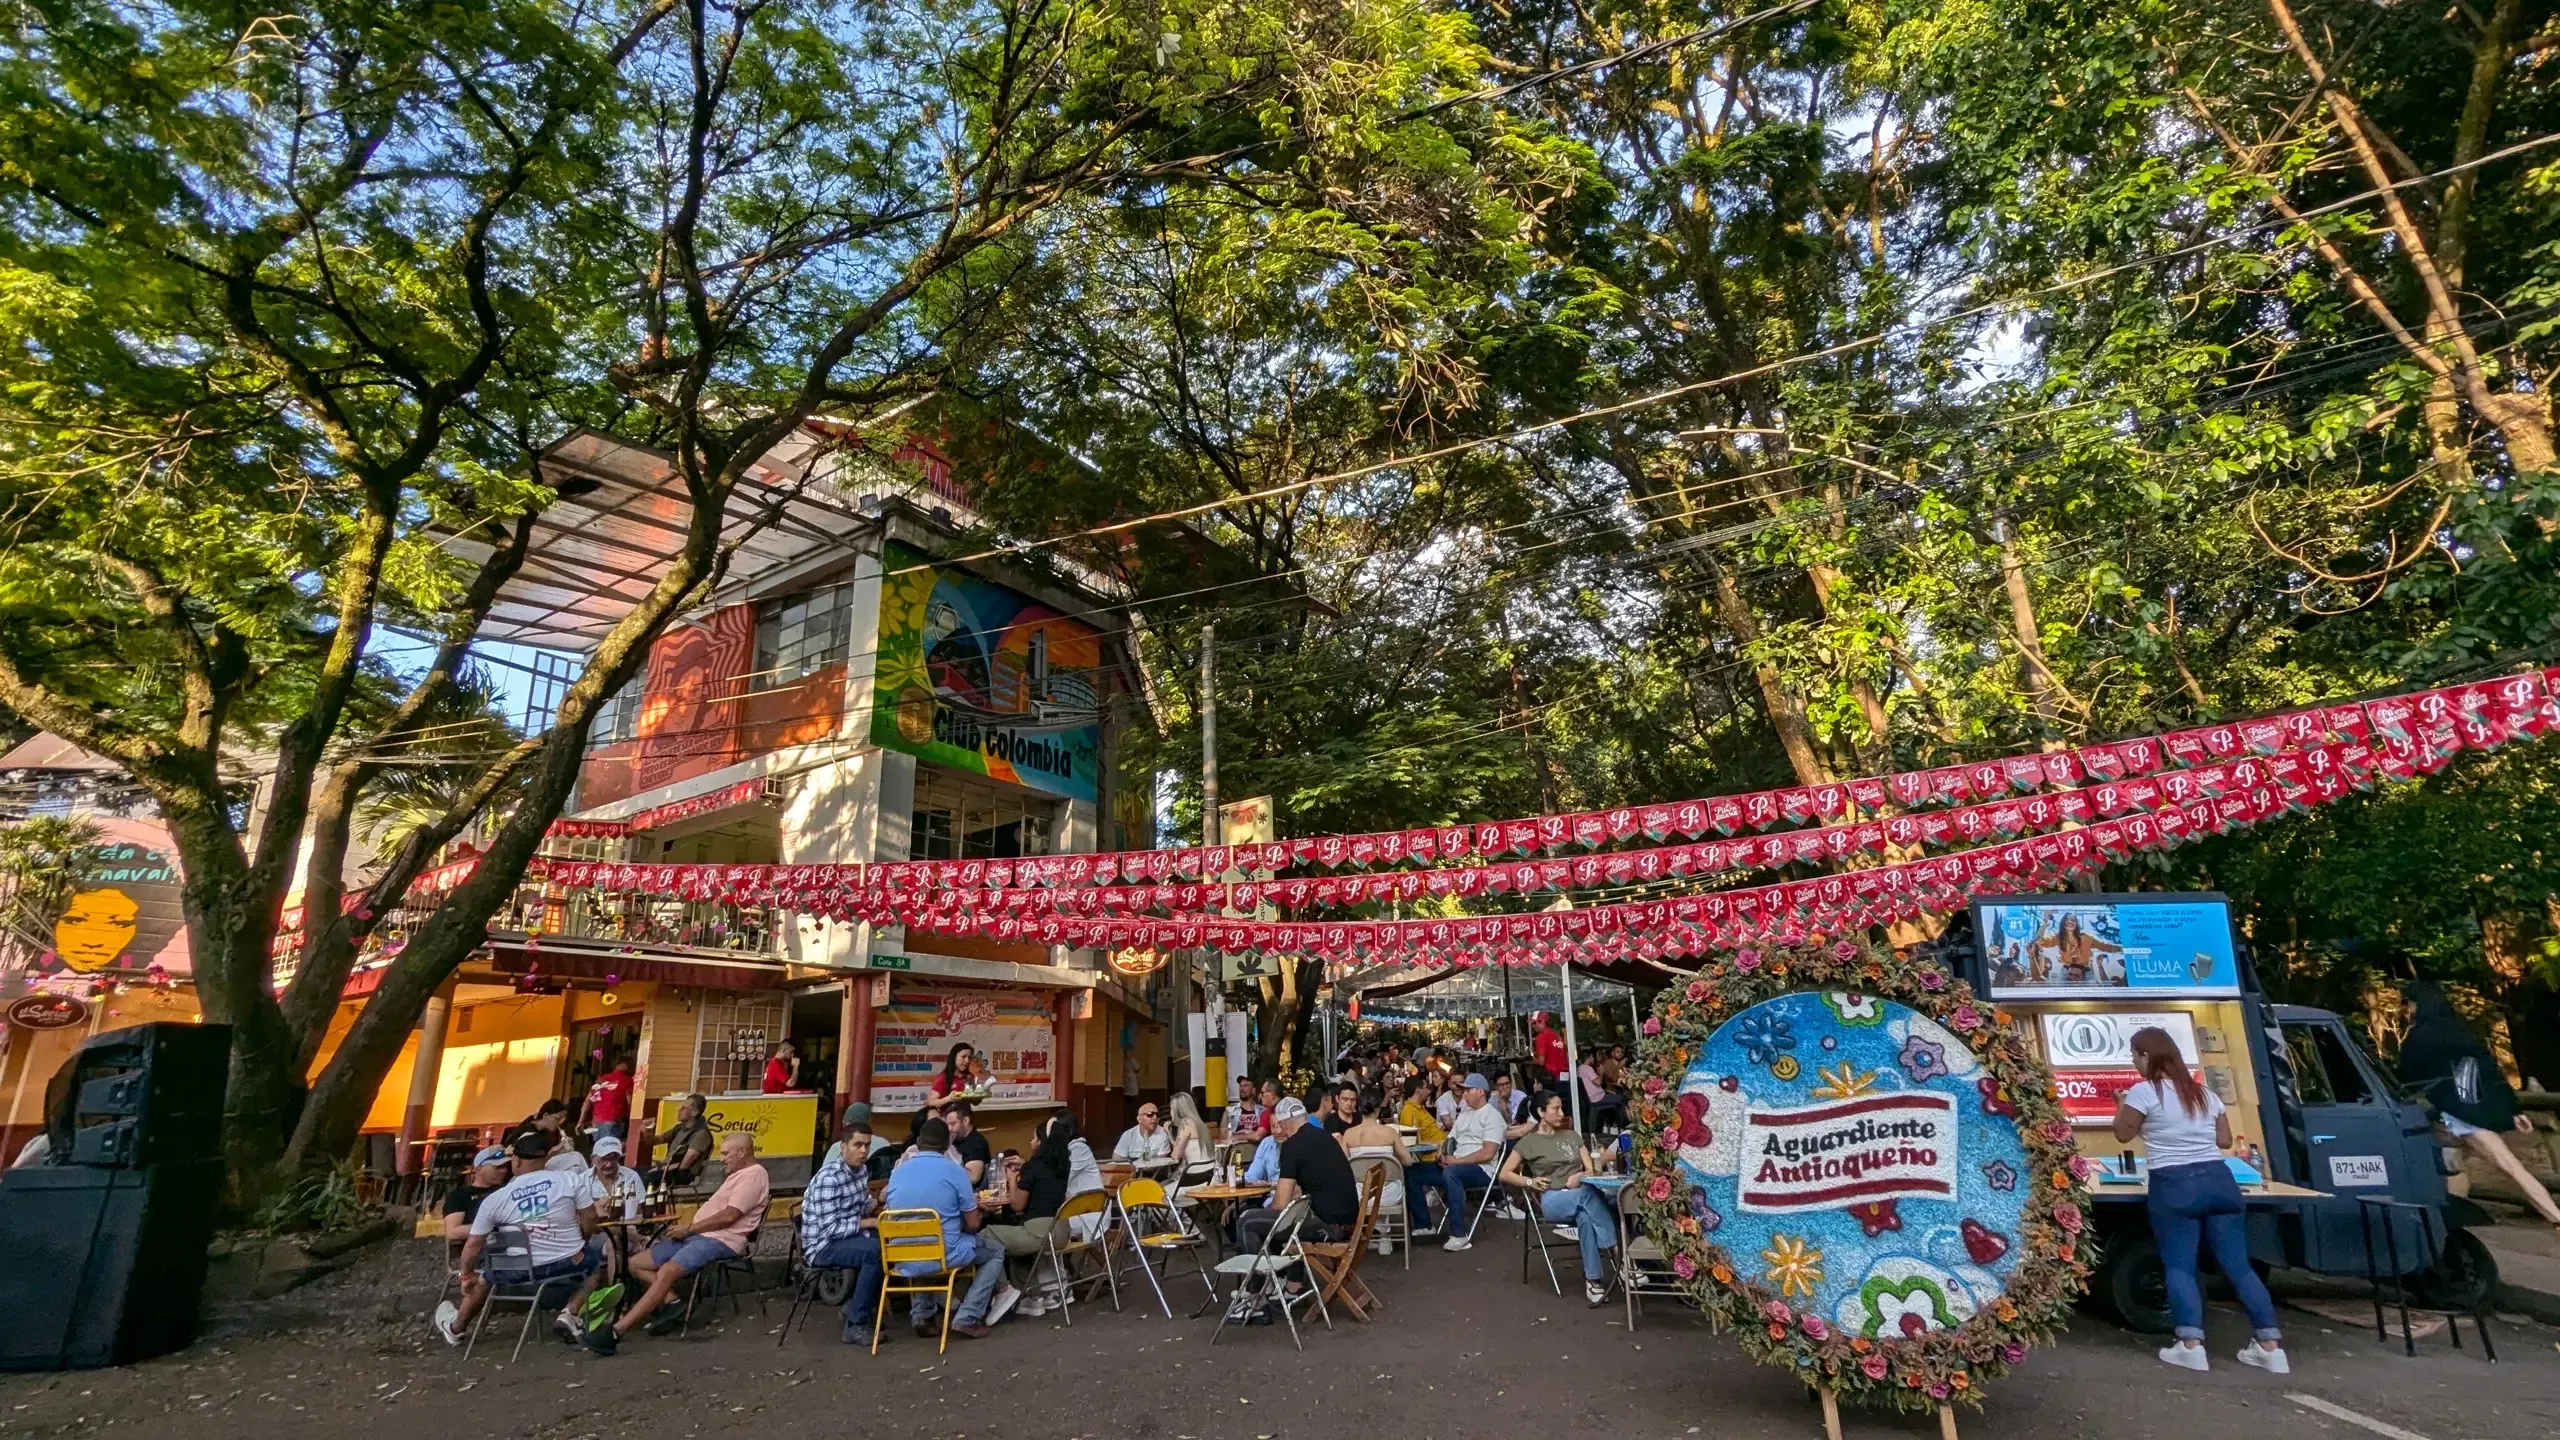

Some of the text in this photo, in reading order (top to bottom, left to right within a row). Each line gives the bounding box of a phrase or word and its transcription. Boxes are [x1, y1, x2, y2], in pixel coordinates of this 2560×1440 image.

[933, 707, 981, 752] Club
[877, 957, 892, 967] Calle
[2132, 960, 2183, 973] ILUMA
[2055, 1081, 2097, 1099] 30%
[706, 1112, 761, 1133] Social
[1762, 1118, 1937, 1162] Aguardiente
[1754, 1138, 1937, 1183] Antioqueño
